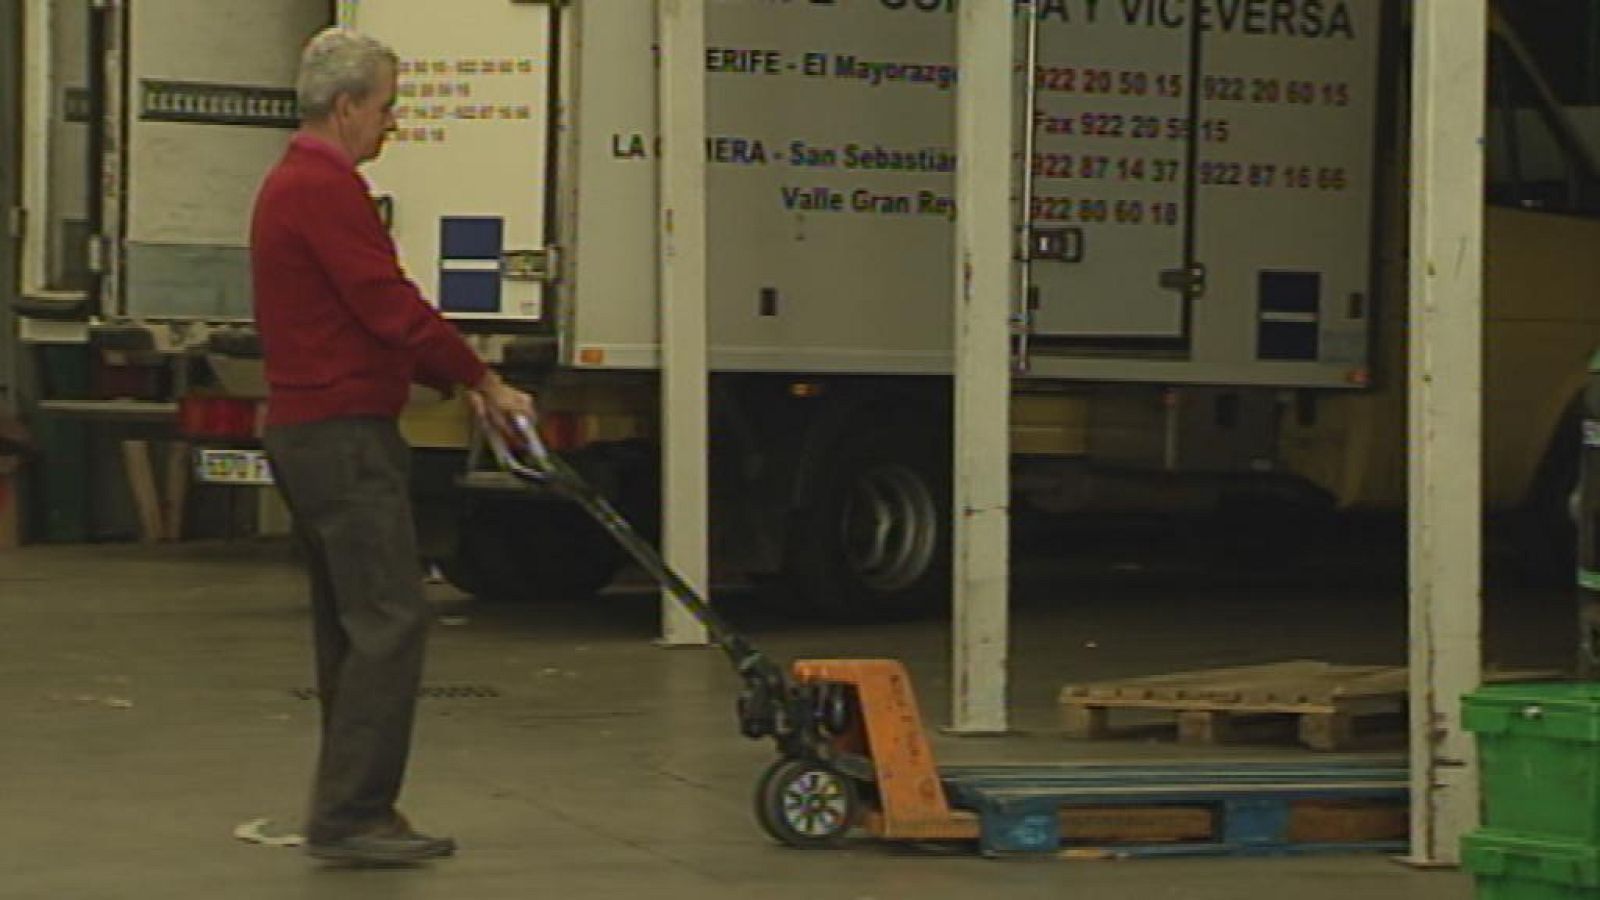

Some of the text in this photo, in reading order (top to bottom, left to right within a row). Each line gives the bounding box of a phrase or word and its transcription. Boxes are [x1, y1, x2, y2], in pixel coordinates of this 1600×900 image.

[804, 53, 826, 76] El
[1083, 71, 1112, 94] 20
[1156, 75, 1182, 98] 15
[1322, 83, 1348, 106] 15
[1080, 113, 1122, 137] 922
[1131, 116, 1159, 138] 20
[1203, 121, 1229, 142] 15
[612, 134, 646, 159] LA
[789, 141, 836, 167] San
[1117, 157, 1144, 180] 14
[1151, 159, 1179, 182] 37
[781, 187, 843, 210] Valle
[851, 189, 909, 214] Gran
